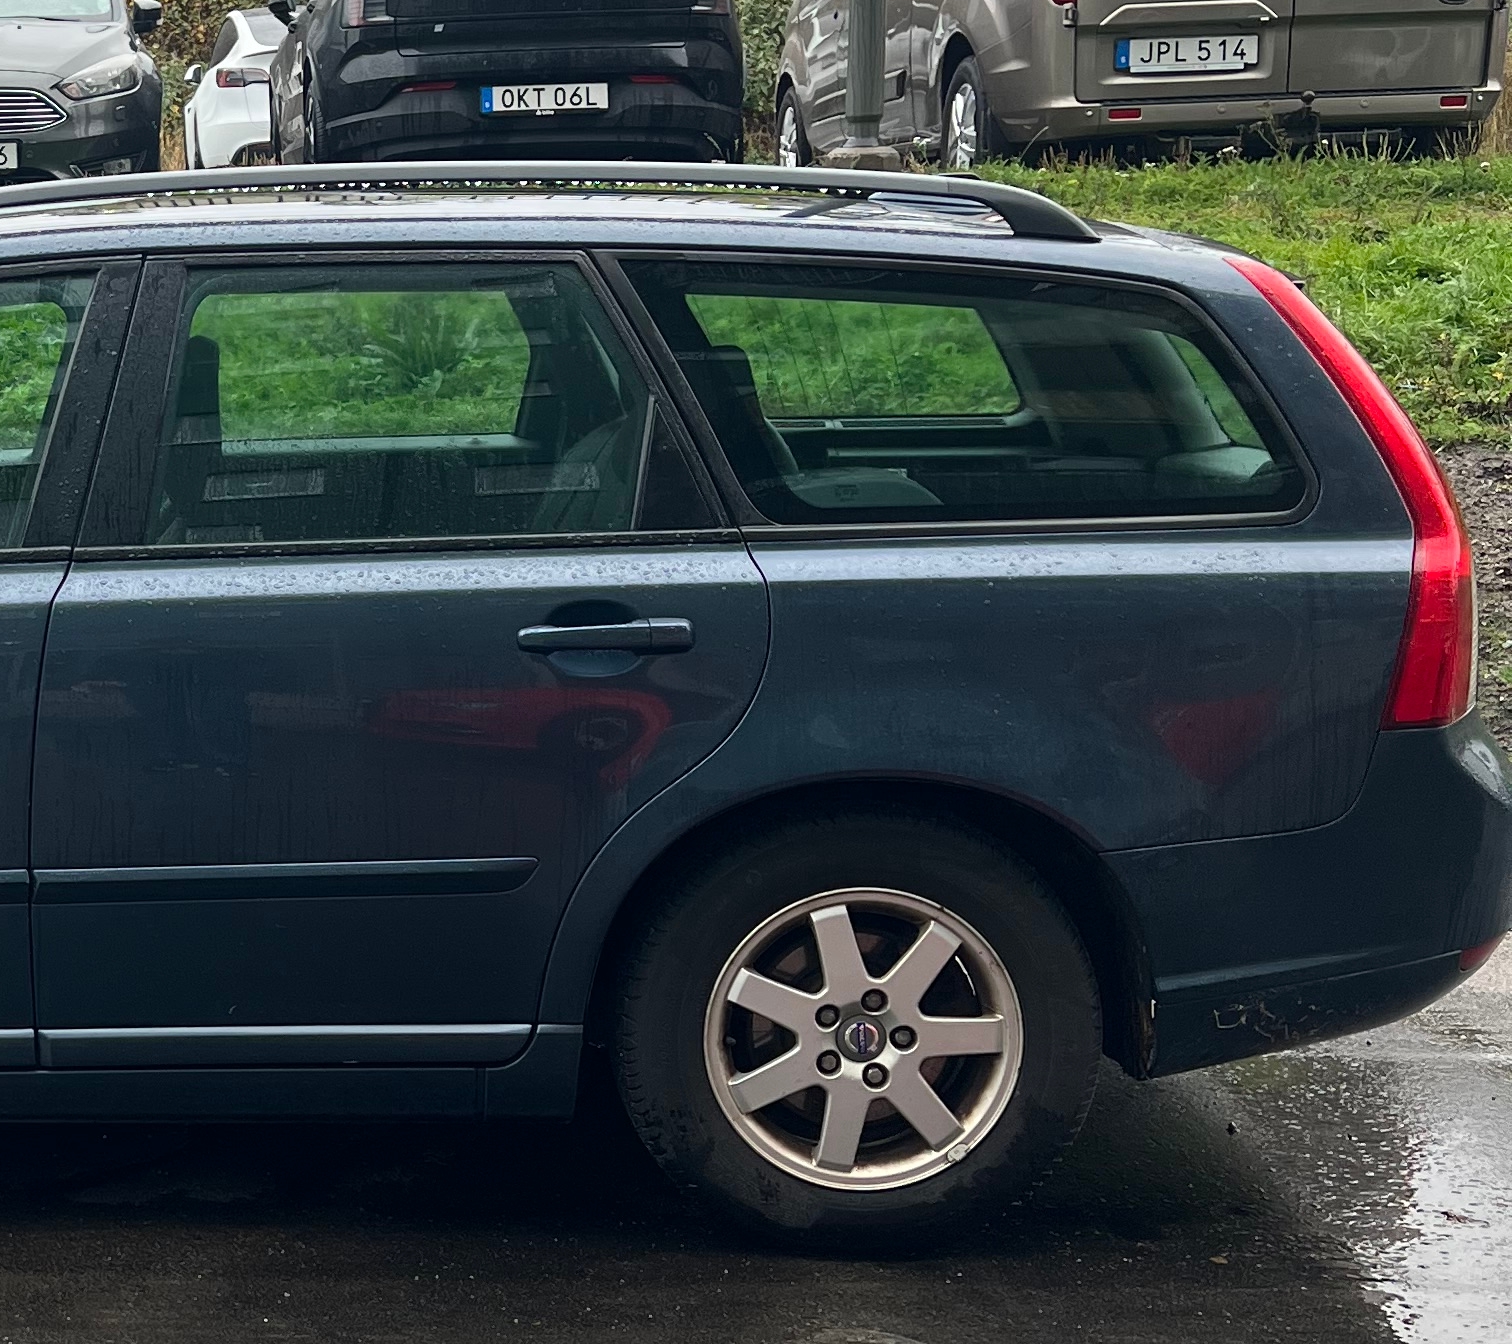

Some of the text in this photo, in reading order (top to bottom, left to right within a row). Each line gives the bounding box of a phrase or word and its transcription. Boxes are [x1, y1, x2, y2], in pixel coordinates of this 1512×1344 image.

[1140, 40, 1187, 64] JPL
[1197, 38, 1247, 62] 514
[554, 86, 598, 107] 06L
